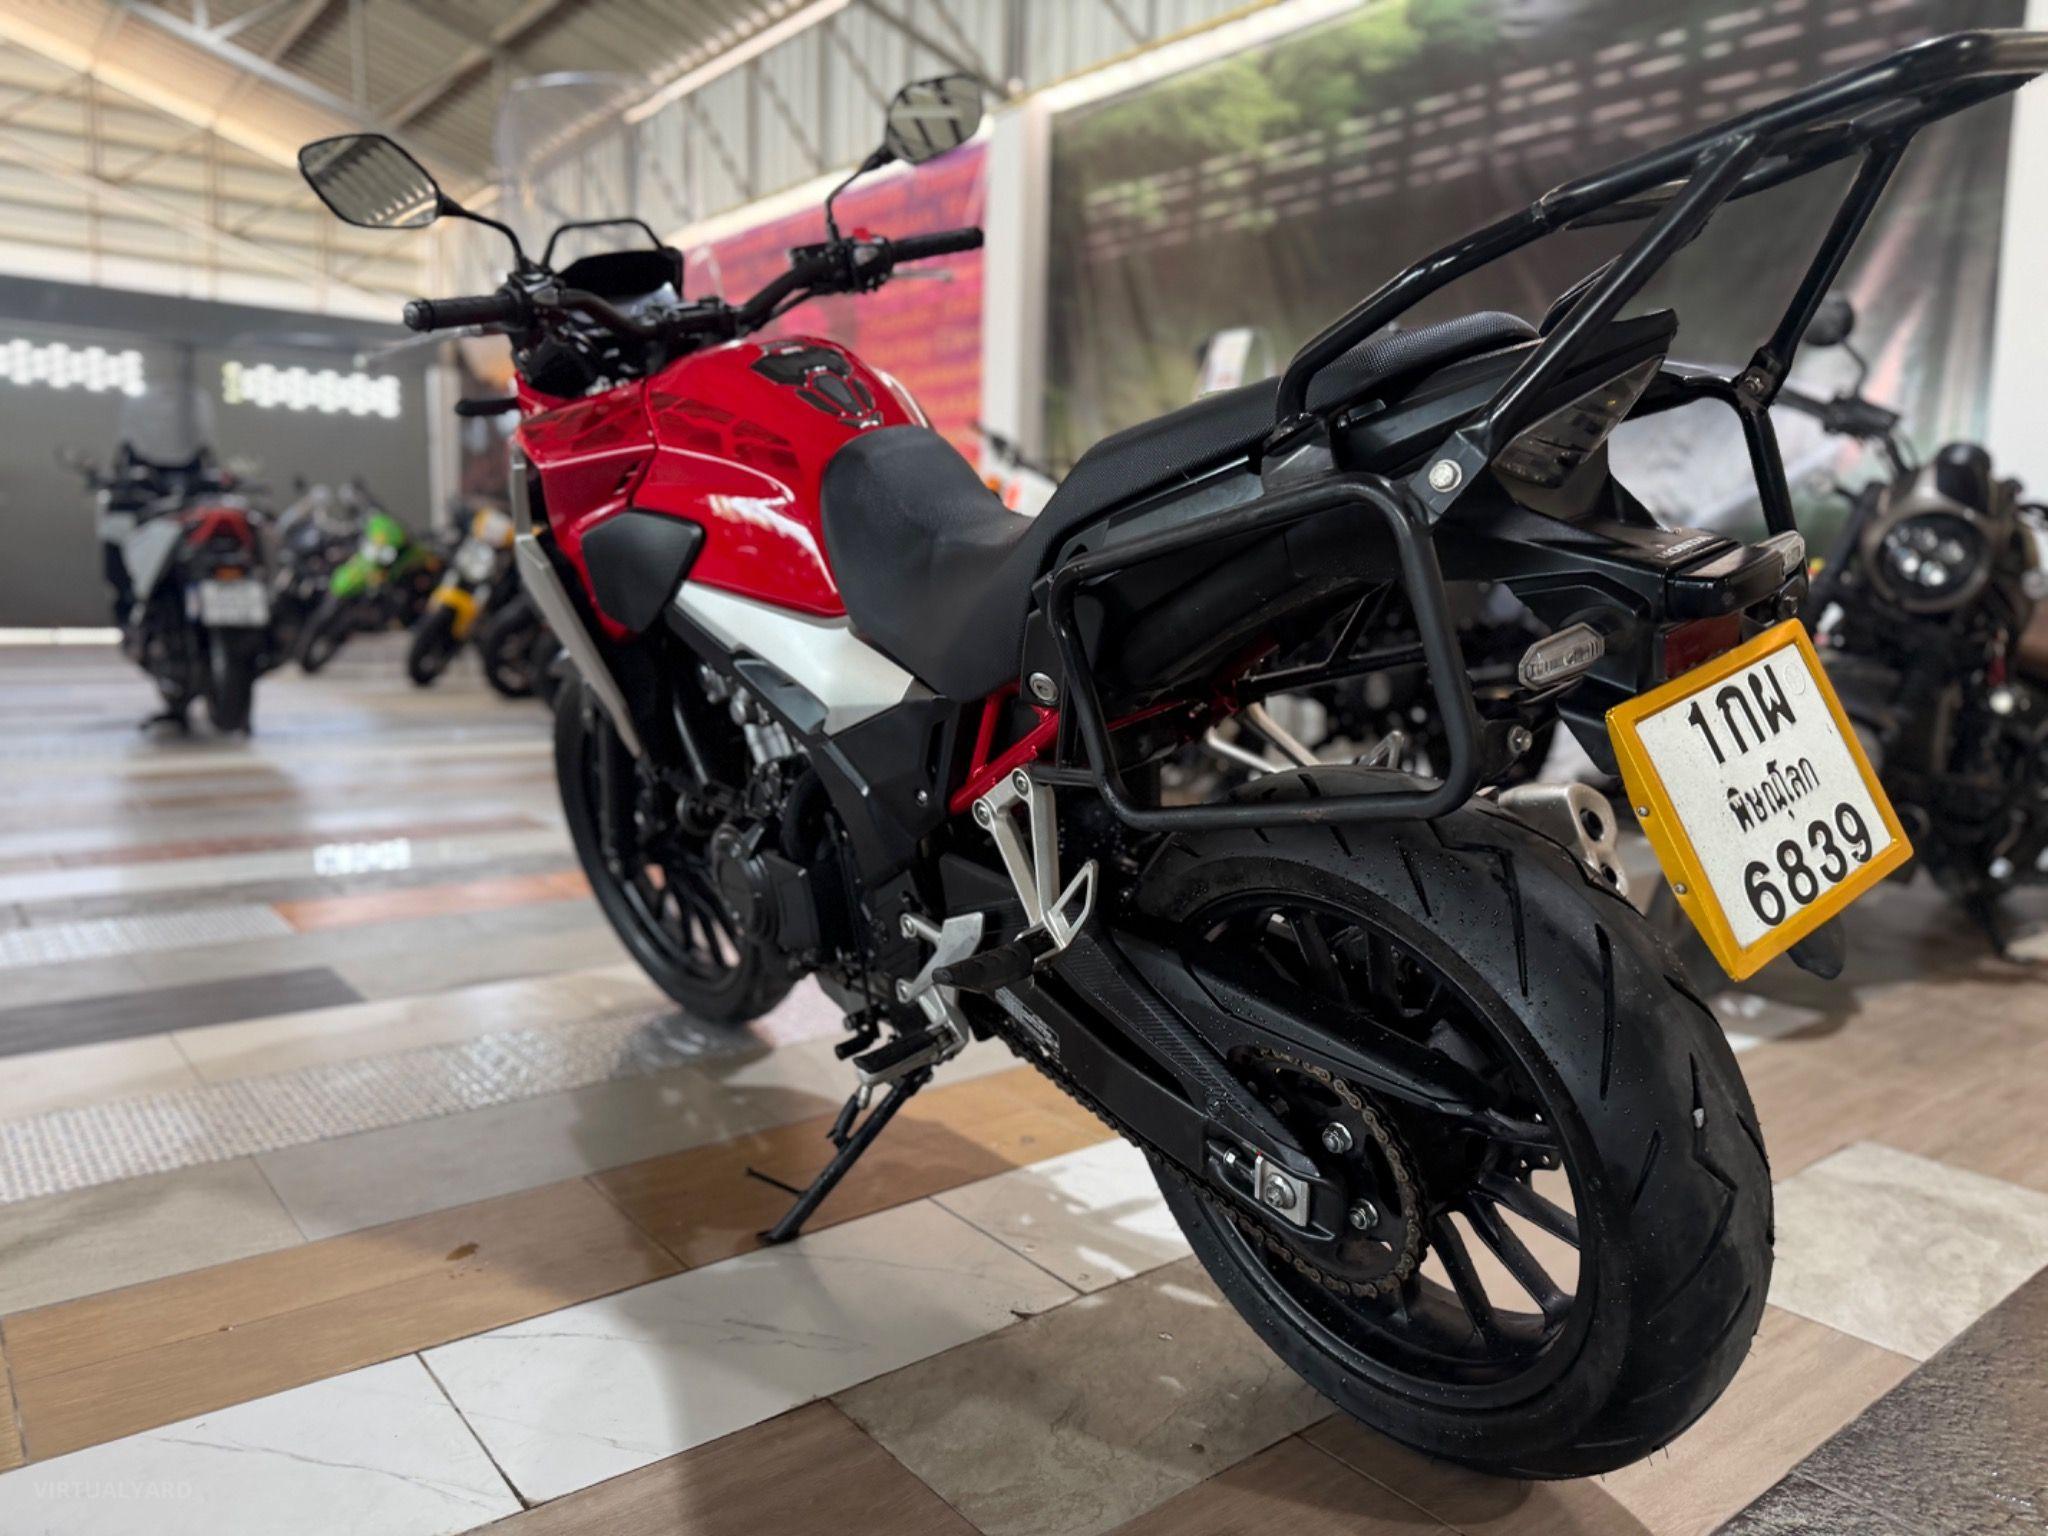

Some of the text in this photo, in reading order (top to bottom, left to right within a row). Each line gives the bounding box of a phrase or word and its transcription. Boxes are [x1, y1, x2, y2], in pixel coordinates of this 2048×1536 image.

[1726, 757, 1821, 834] พิษณุโลก
[1743, 802, 1873, 927] 6839
